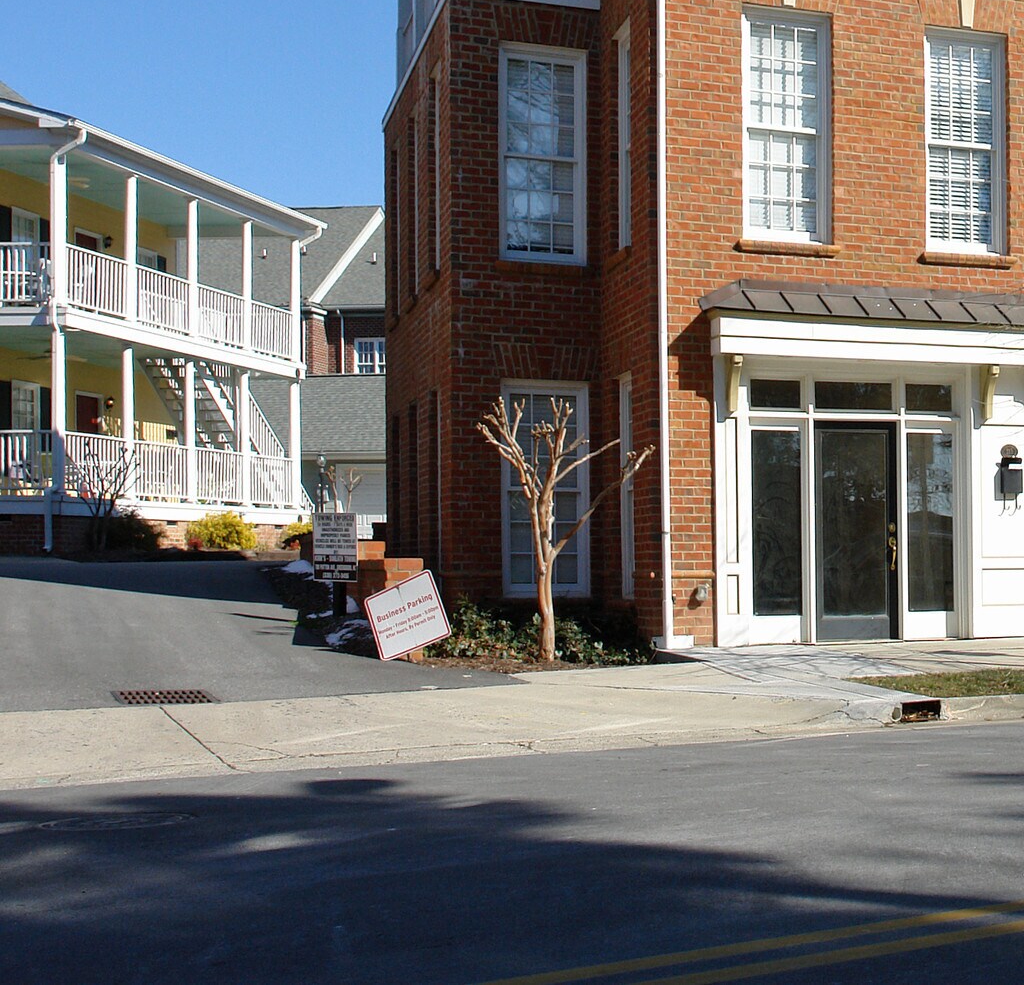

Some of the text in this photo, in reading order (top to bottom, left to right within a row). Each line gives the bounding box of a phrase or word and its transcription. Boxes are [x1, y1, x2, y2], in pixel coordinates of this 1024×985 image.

[376, 593, 433, 623] Business Parking
[395, 619, 408, 629] Friday
